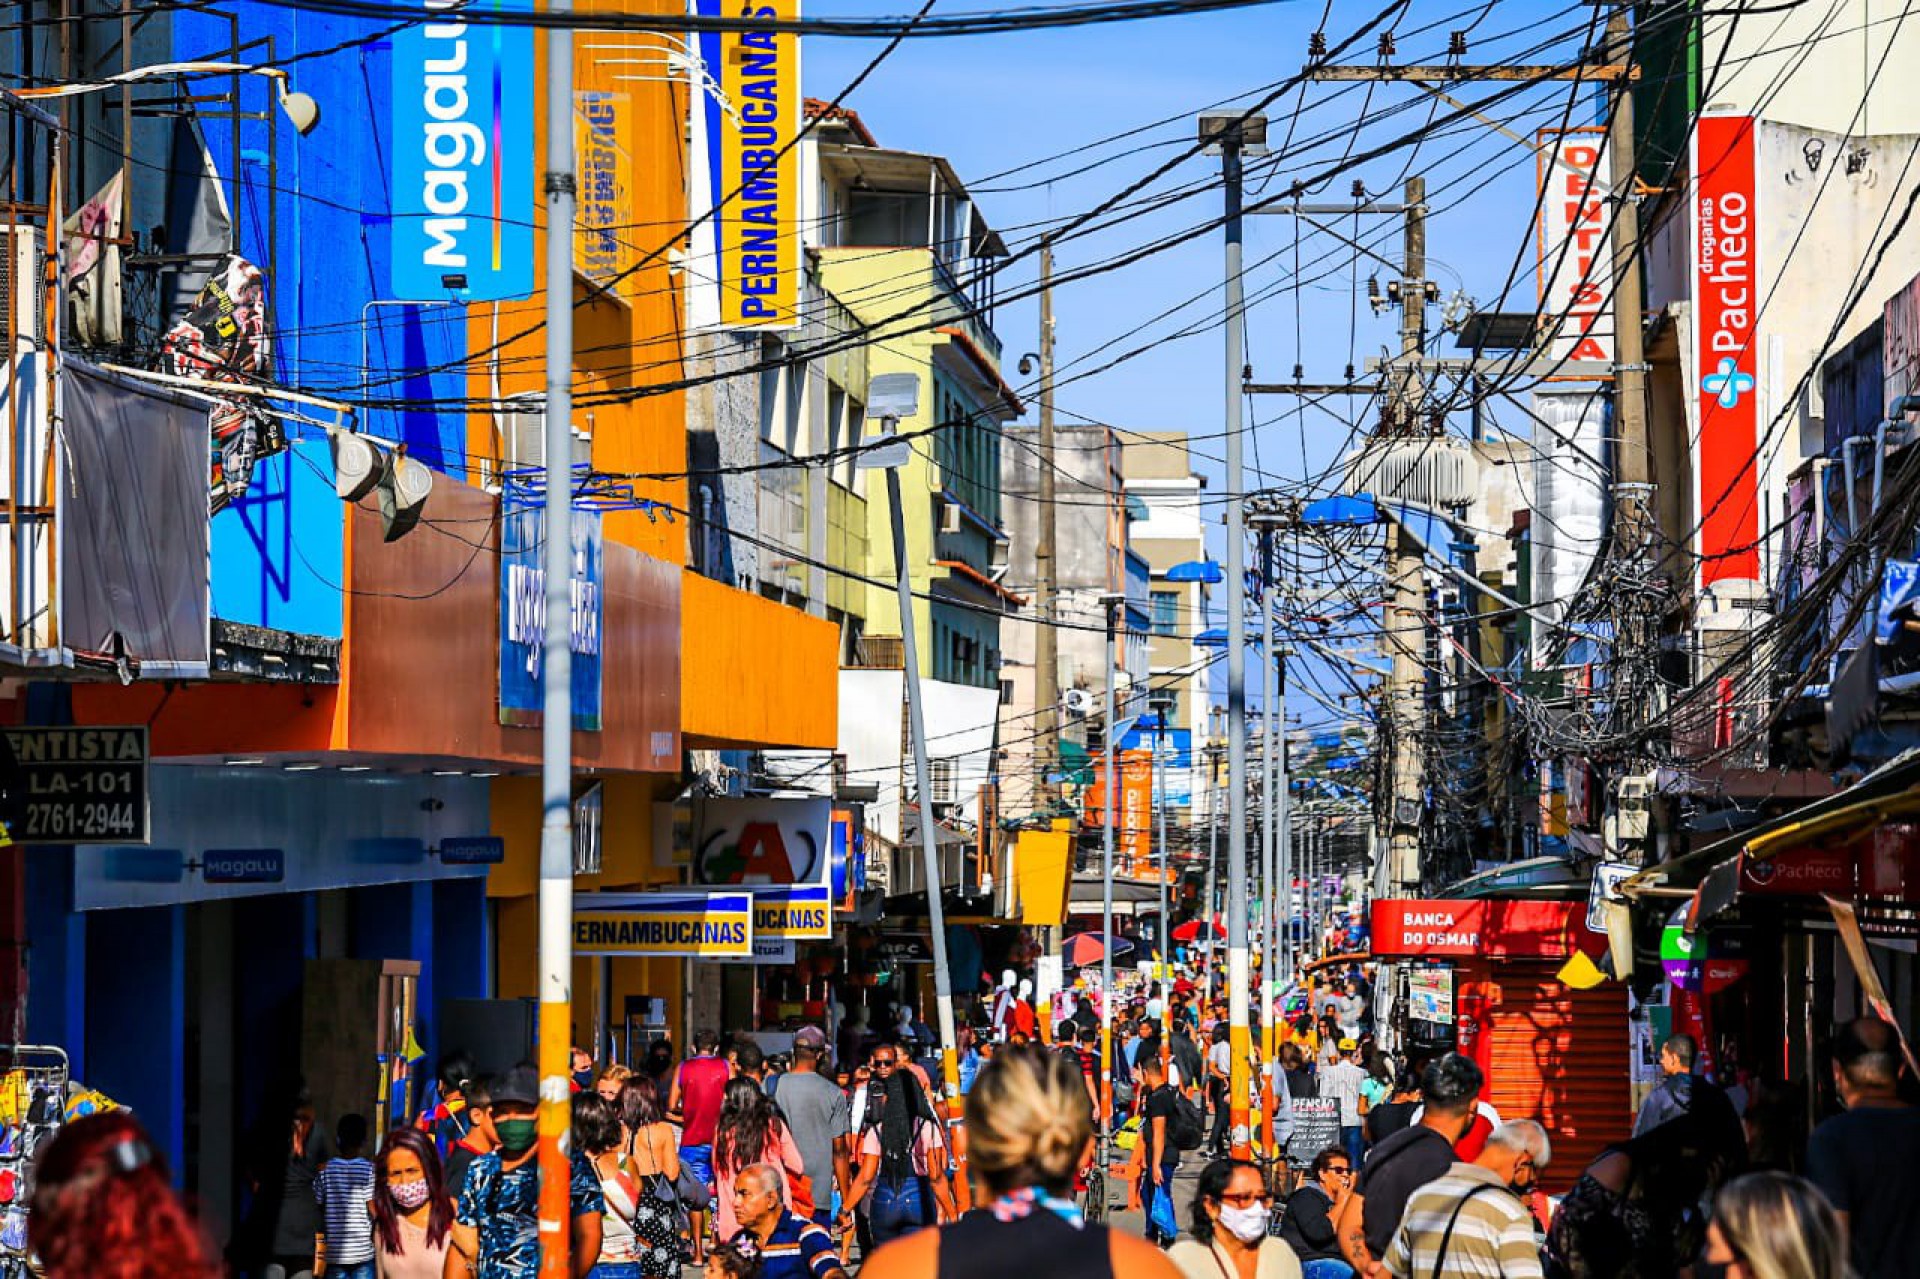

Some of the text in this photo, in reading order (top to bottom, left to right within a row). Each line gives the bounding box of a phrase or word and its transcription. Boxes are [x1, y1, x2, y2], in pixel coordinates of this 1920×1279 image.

[740, 5, 778, 319] PERNAMBUCANAS
[1699, 197, 1716, 273] drogarias
[1563, 146, 1607, 360] DENTISTA
[1709, 192, 1748, 352] Pacheco
[27, 803, 134, 834] 2761-2944
[1776, 863, 1842, 878] Pacheco
[1403, 912, 1454, 926] BANCA
[1403, 932, 1423, 945] DO
[1427, 932, 1479, 946] OSMAR
